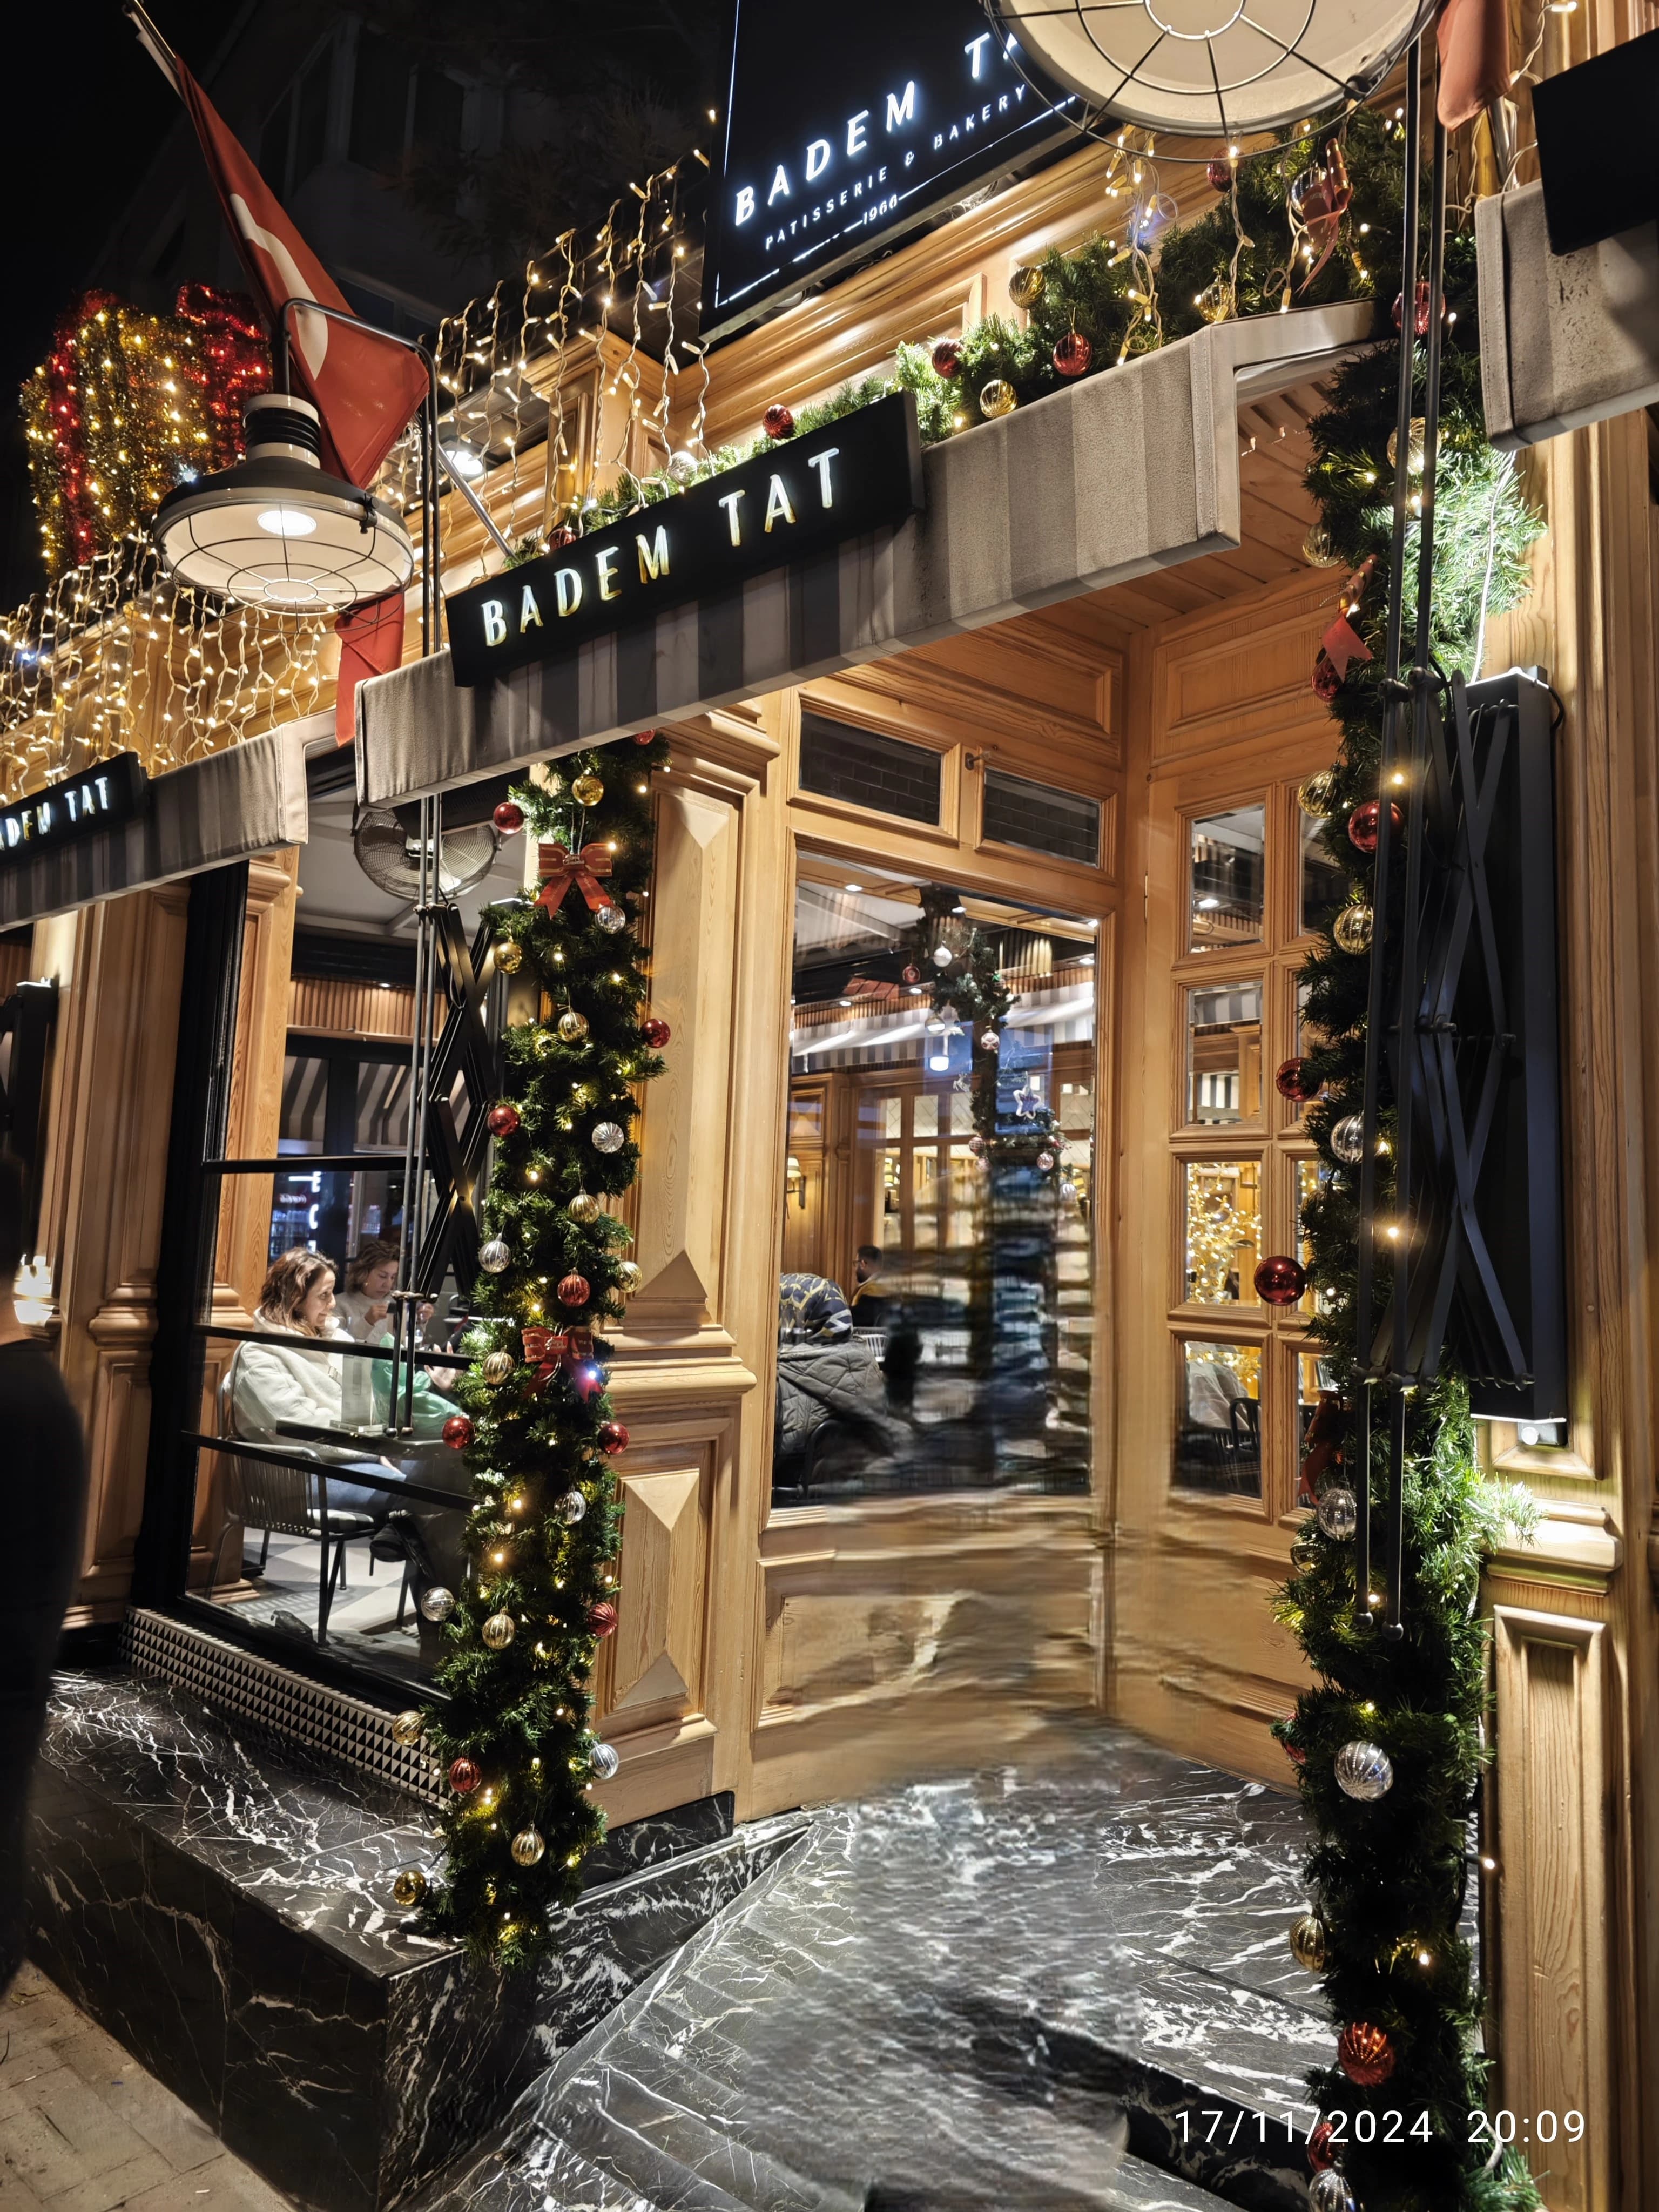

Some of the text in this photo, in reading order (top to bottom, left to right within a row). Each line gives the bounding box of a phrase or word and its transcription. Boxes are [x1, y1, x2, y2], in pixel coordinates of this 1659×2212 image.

[734, 80, 917, 227] BADEM
[765, 84, 1026, 251] PATISSERIE & BAKERY
[481, 447, 840, 648] BADEM TAT
[64, 777, 109, 822] TAT
